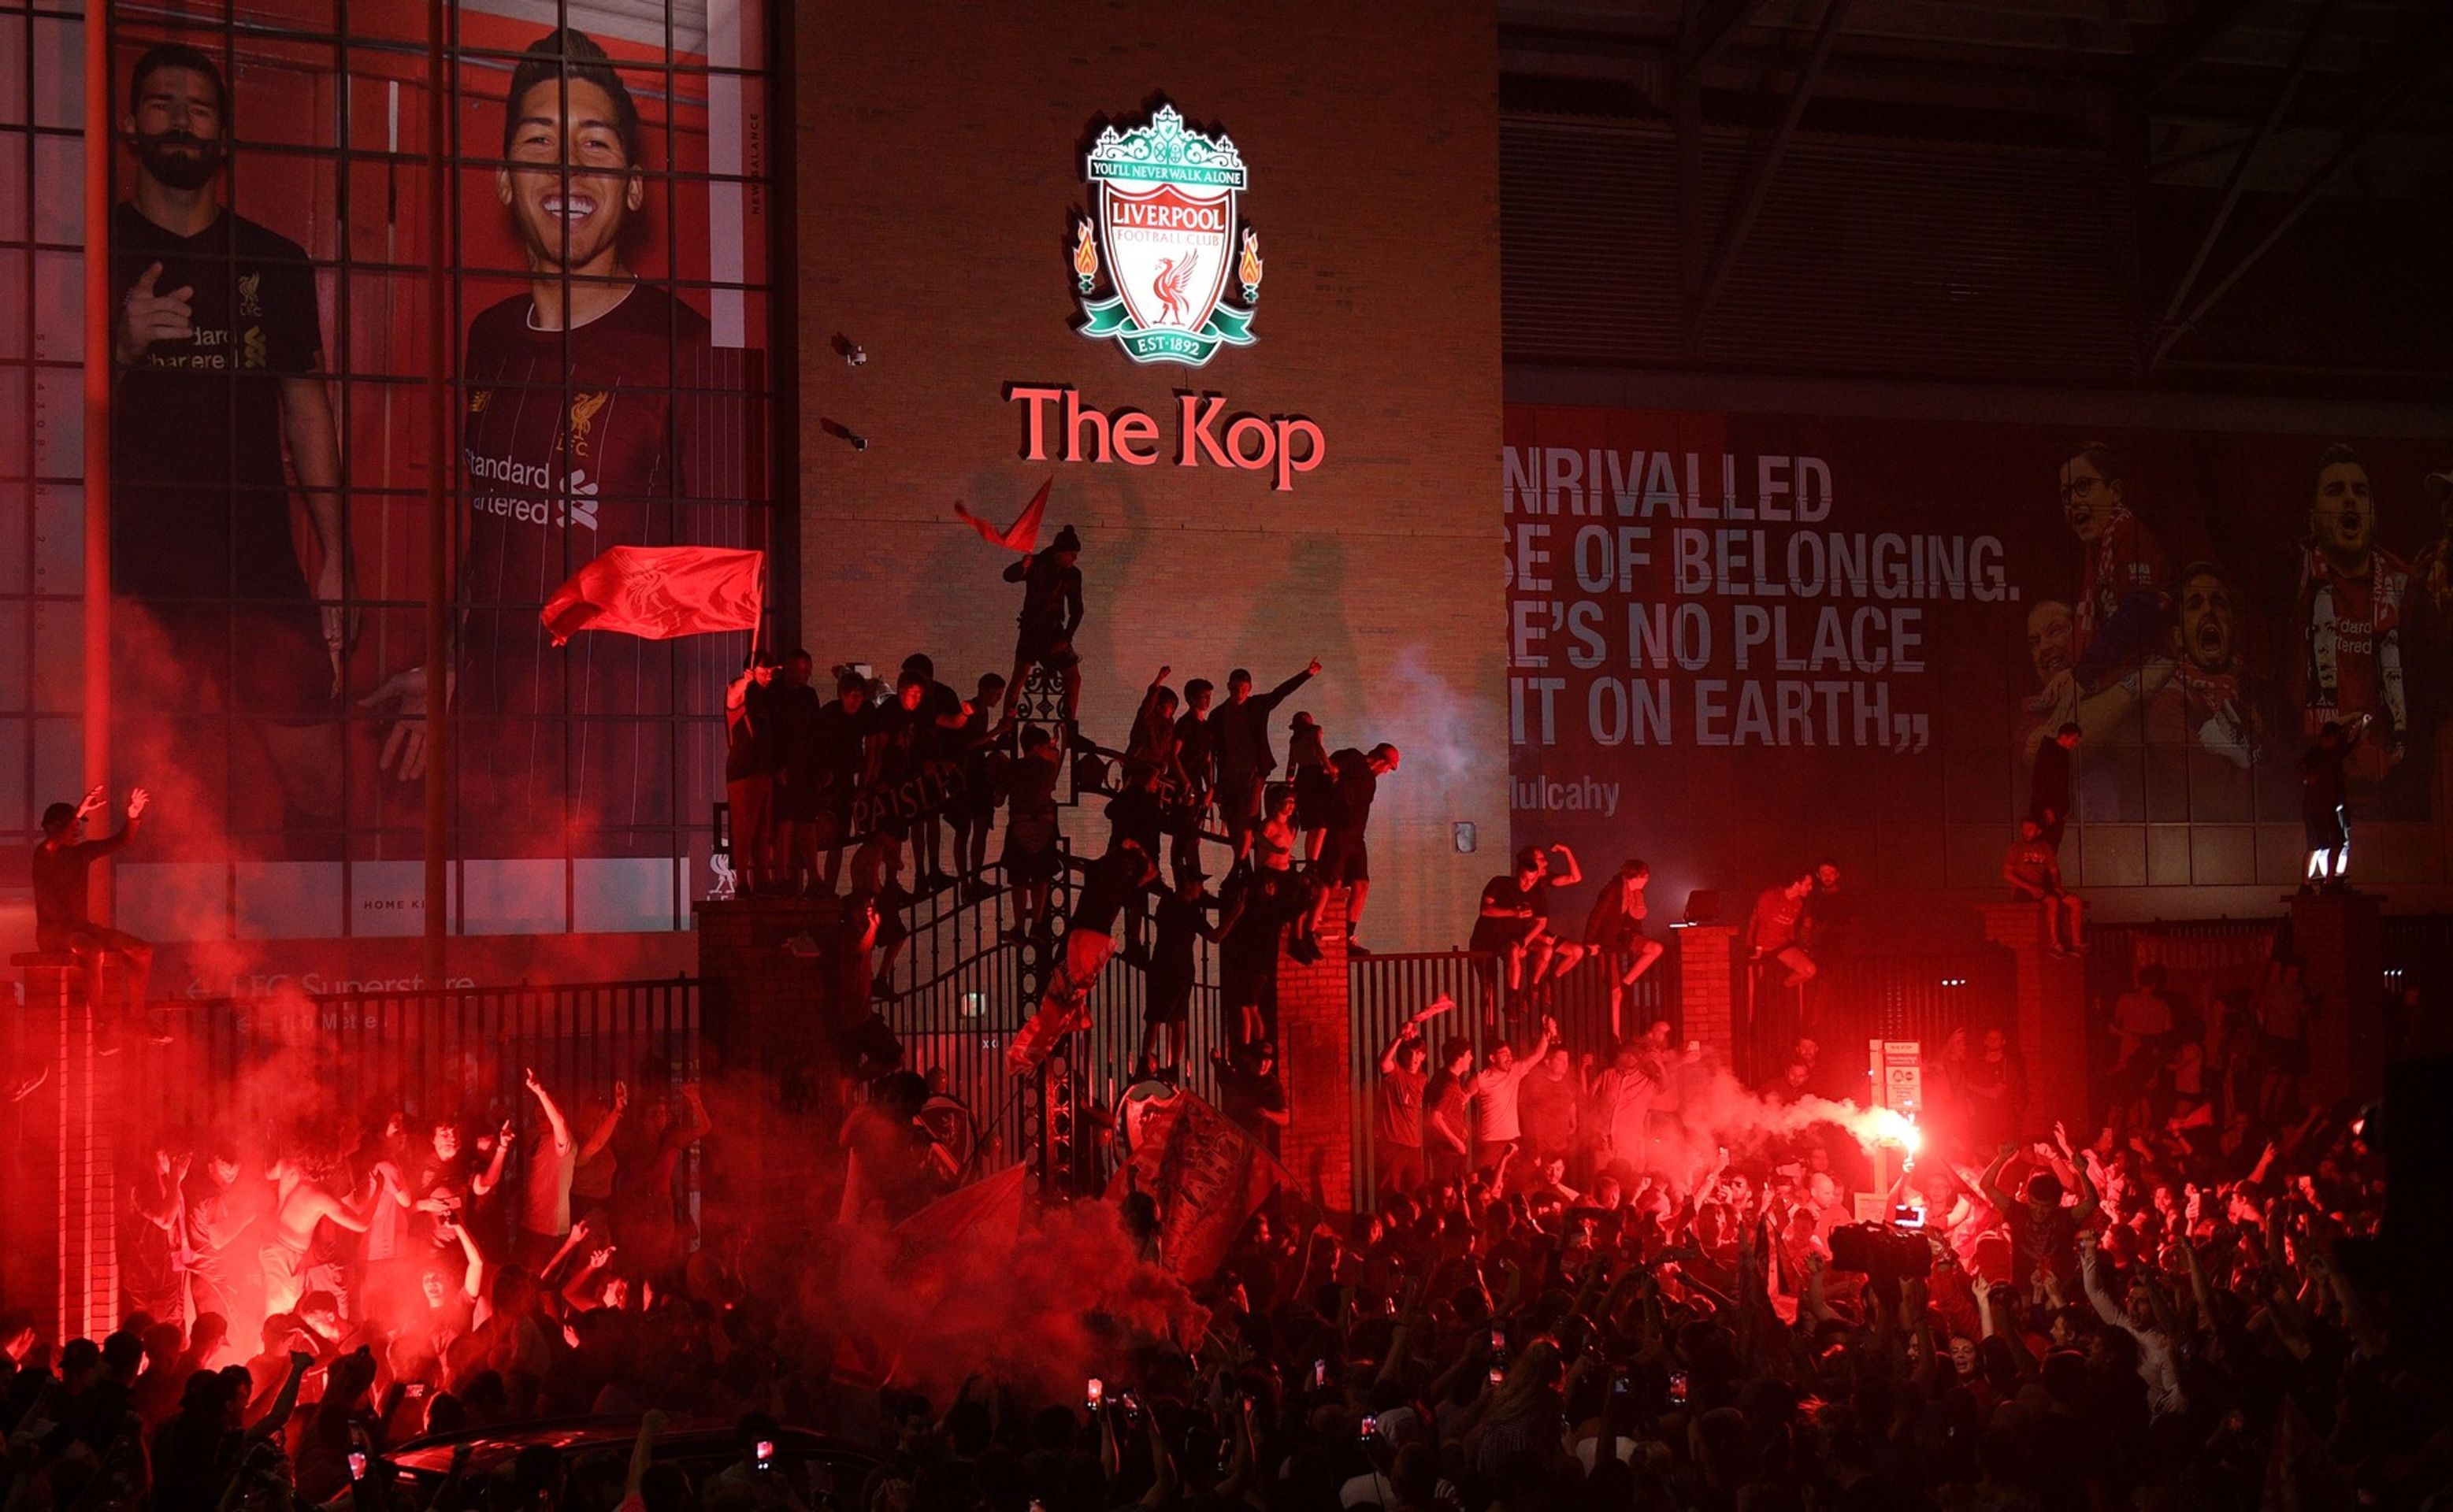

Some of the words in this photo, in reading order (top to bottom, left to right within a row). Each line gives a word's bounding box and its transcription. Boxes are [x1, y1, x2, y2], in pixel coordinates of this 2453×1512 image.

[750, 113, 759, 179] BALANCE
[751, 183, 760, 215] NEW
[1132, 165, 1168, 179] NEVER
[1169, 169, 1202, 182] WALK
[1203, 171, 1241, 185] ALONE
[1112, 202, 1225, 231] LIVERPOOL
[1116, 228, 1182, 245] FOOTBALL
[1186, 233, 1220, 246] CLUB
[1010, 387, 1160, 467] The
[1177, 394, 1326, 492] Kop
[1504, 523, 1553, 592] E
[1575, 524, 1652, 594] OF
[1672, 527, 2021, 602] BELONGING.
[1506, 600, 1607, 669] E’S
[1627, 602, 1712, 671] NO
[1734, 604, 1925, 673] PLACE
[1510, 676, 1567, 745] IT
[1588, 676, 1673, 746] ON
[364, 900, 405, 910] HOME
